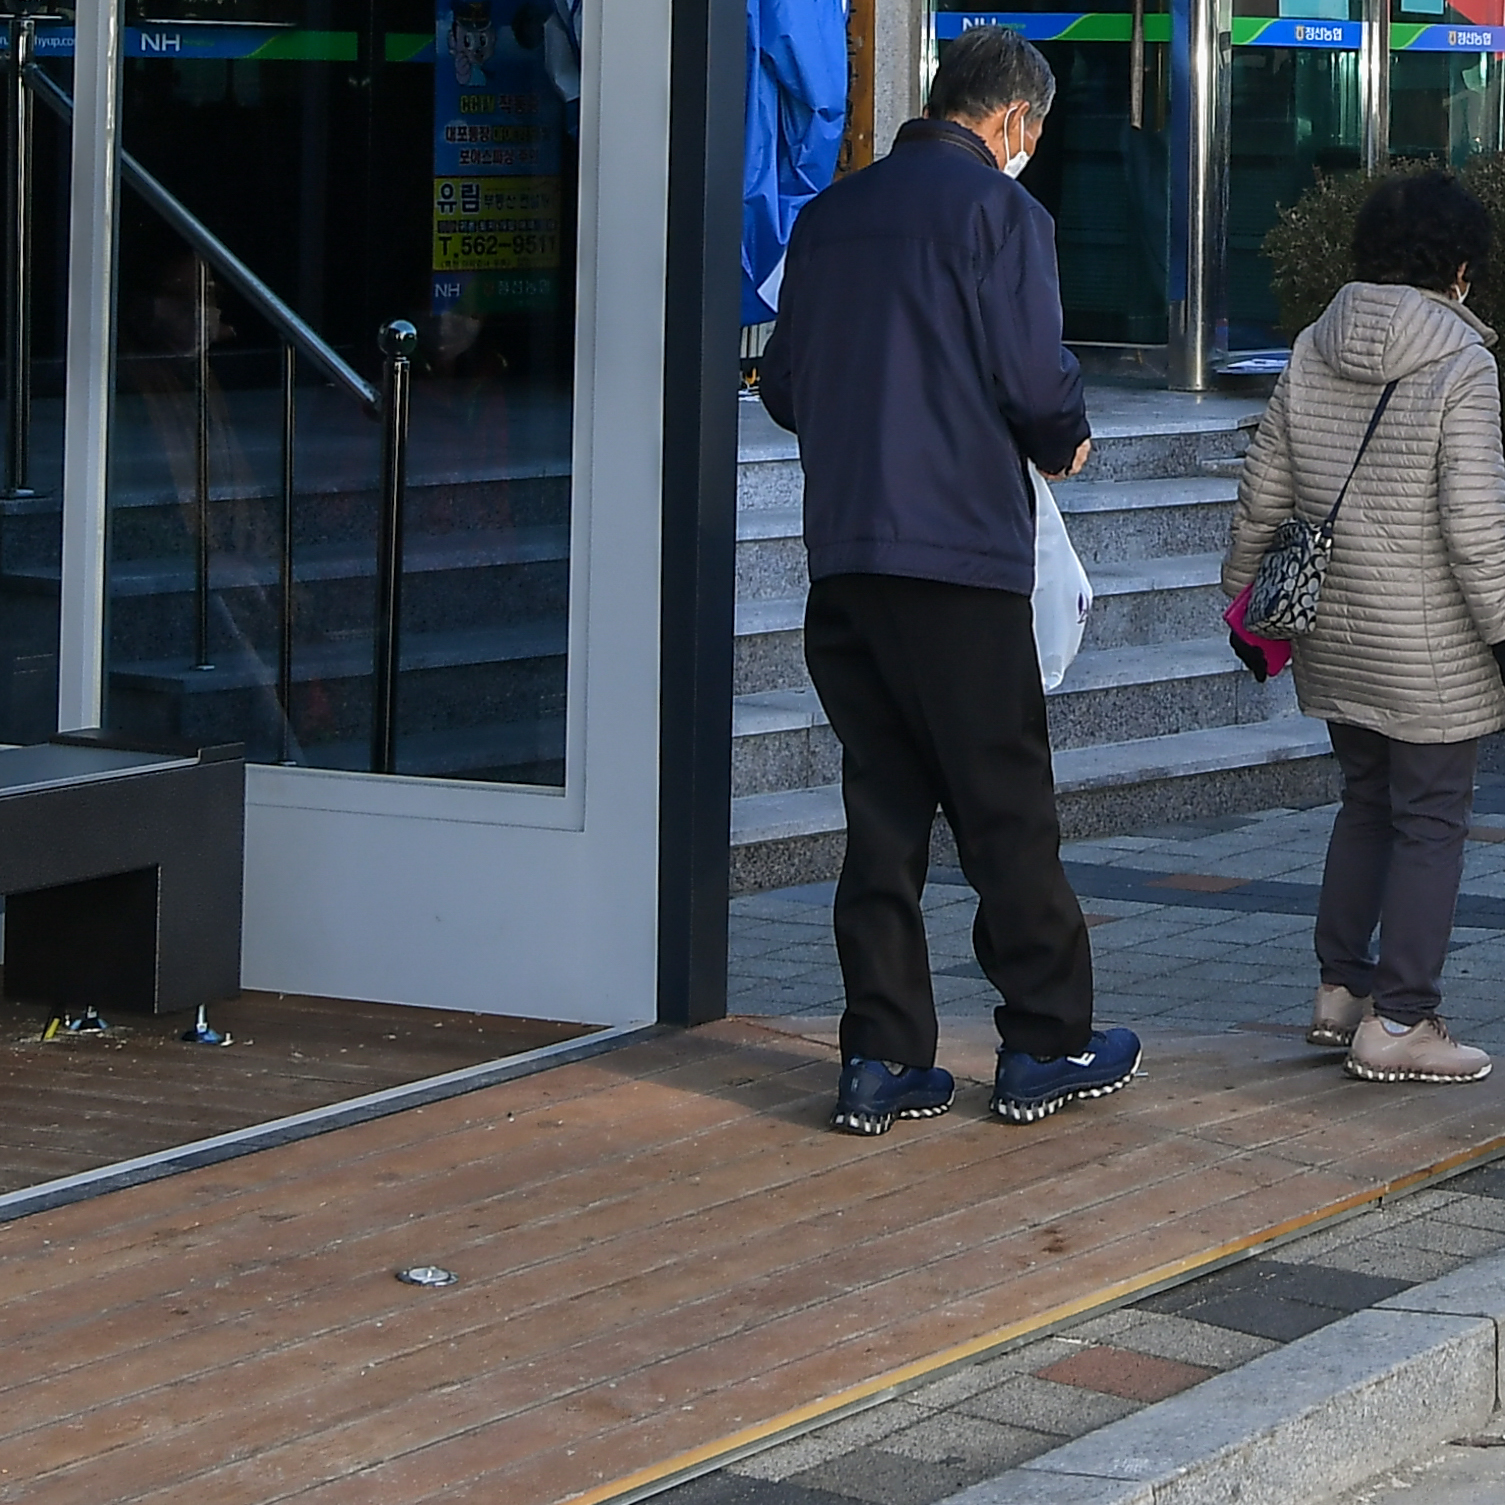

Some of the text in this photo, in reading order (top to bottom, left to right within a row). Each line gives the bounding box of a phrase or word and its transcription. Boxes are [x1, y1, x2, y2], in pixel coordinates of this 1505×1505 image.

[141, 33, 181, 52] NH
[437, 182, 481, 215] 유림
[434, 283, 461, 298] NH
